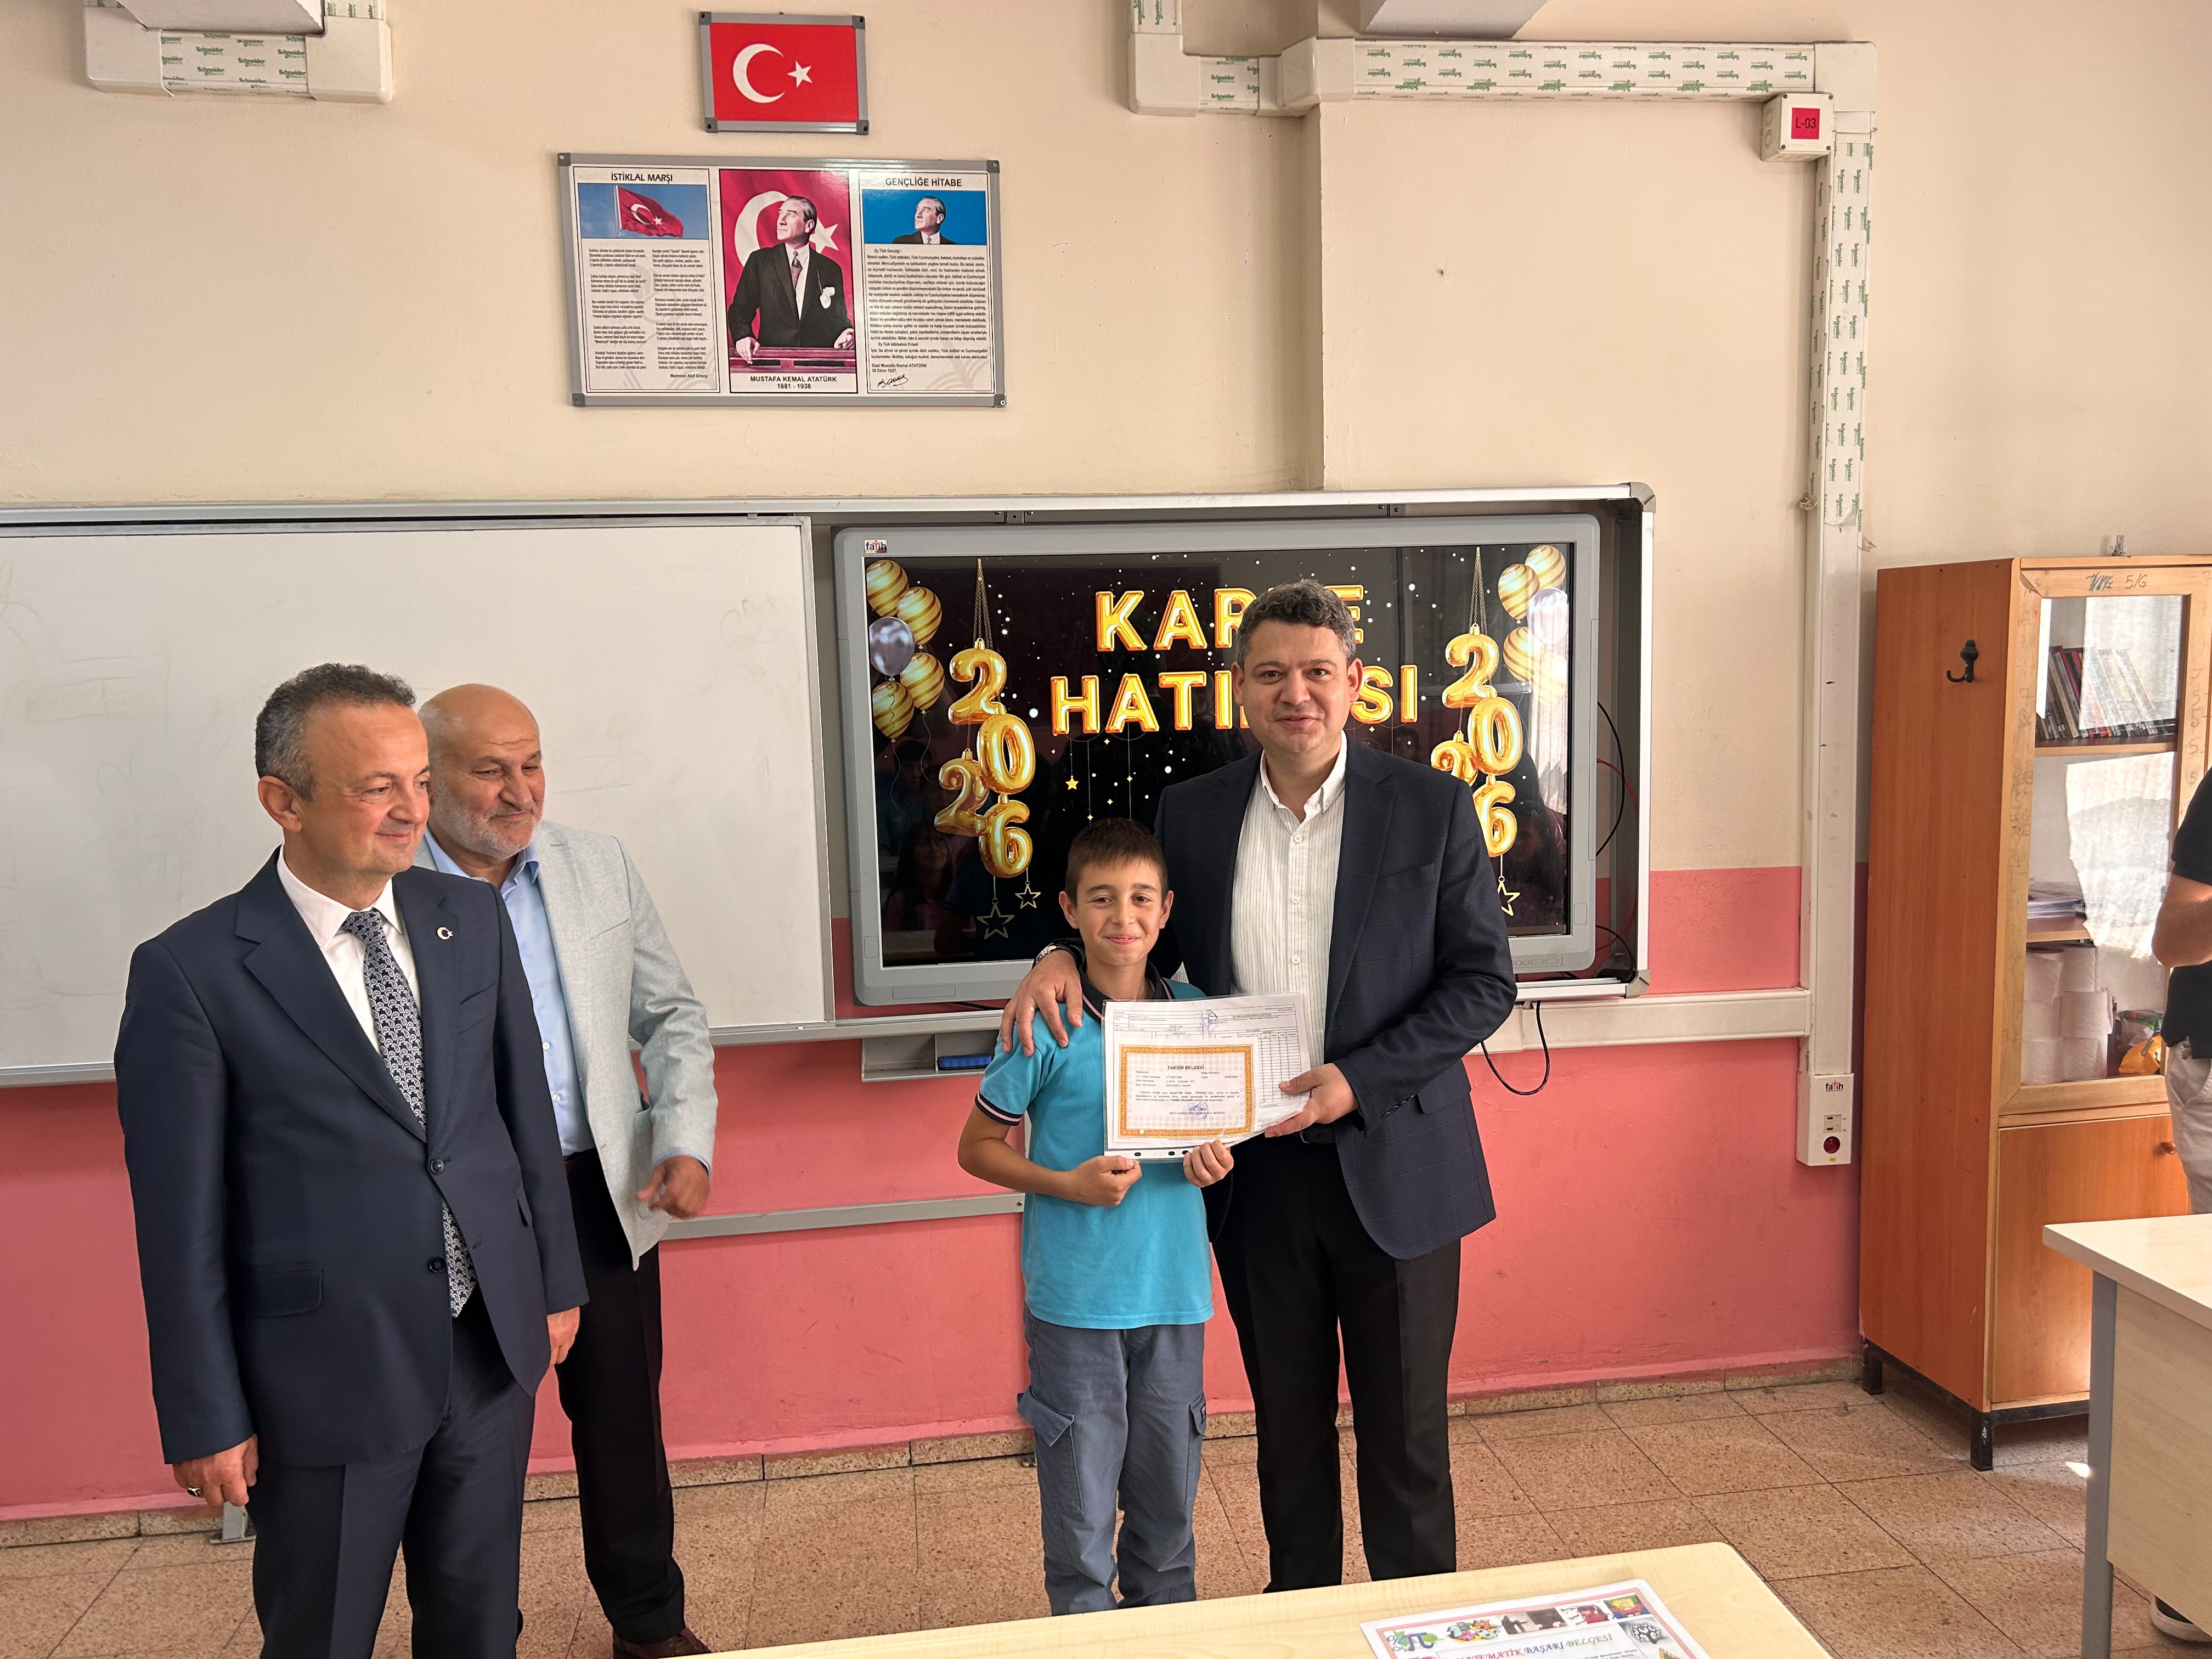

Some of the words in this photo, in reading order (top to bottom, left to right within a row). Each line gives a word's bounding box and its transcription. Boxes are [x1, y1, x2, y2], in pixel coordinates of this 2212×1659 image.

[278, 49, 304, 58] Schneider
[1367, 49, 1391, 58] Schneider
[1438, 49, 1462, 58] Schneider
[1509, 50, 1532, 59] Schneider
[1578, 51, 1602, 60] Schneider
[1648, 51, 1671, 60] Schneider
[1717, 52, 1740, 60] Schneider
[1785, 52, 1808, 61] Schneider
[238, 58, 265, 66] Schneider
[1403, 58, 1426, 67] Schneider
[1474, 59, 1497, 68] Schneider
[1543, 60, 1567, 69] Schneider
[1613, 61, 1637, 70] Schneider
[1682, 61, 1705, 70] Schneider
[1751, 61, 1773, 70] Schneider
[279, 69, 306, 78] Schneider
[1367, 68, 1391, 77] Schneider
[1438, 68, 1462, 77] Schneider
[1509, 69, 1532, 78] Schneider
[1578, 70, 1602, 79] Schneider
[1647, 70, 1671, 79] Schneider
[1717, 71, 1739, 79] Schneider
[1784, 71, 1807, 80] Schneider
[1211, 75, 1235, 83] Schneider
[1796, 117, 1816, 128] L-03
[611, 171, 645, 181] İSTİKLAL
[647, 174, 673, 183] MARŞI
[885, 177, 929, 188] GENÇLİĞE
[932, 177, 962, 187] HİTABE
[866, 540, 887, 550] fatih
[2125, 573, 2147, 589] 5/6
[1096, 584, 1364, 651] KARE
[1050, 665, 1418, 735] HATISI
[1826, 1080, 1843, 1091] fatih
[1455, 1648, 1525, 1659] ATEMATİK
[1524, 1641, 1564, 1654] BAŞARI
[1566, 1633, 1613, 1647] BELGESİ
